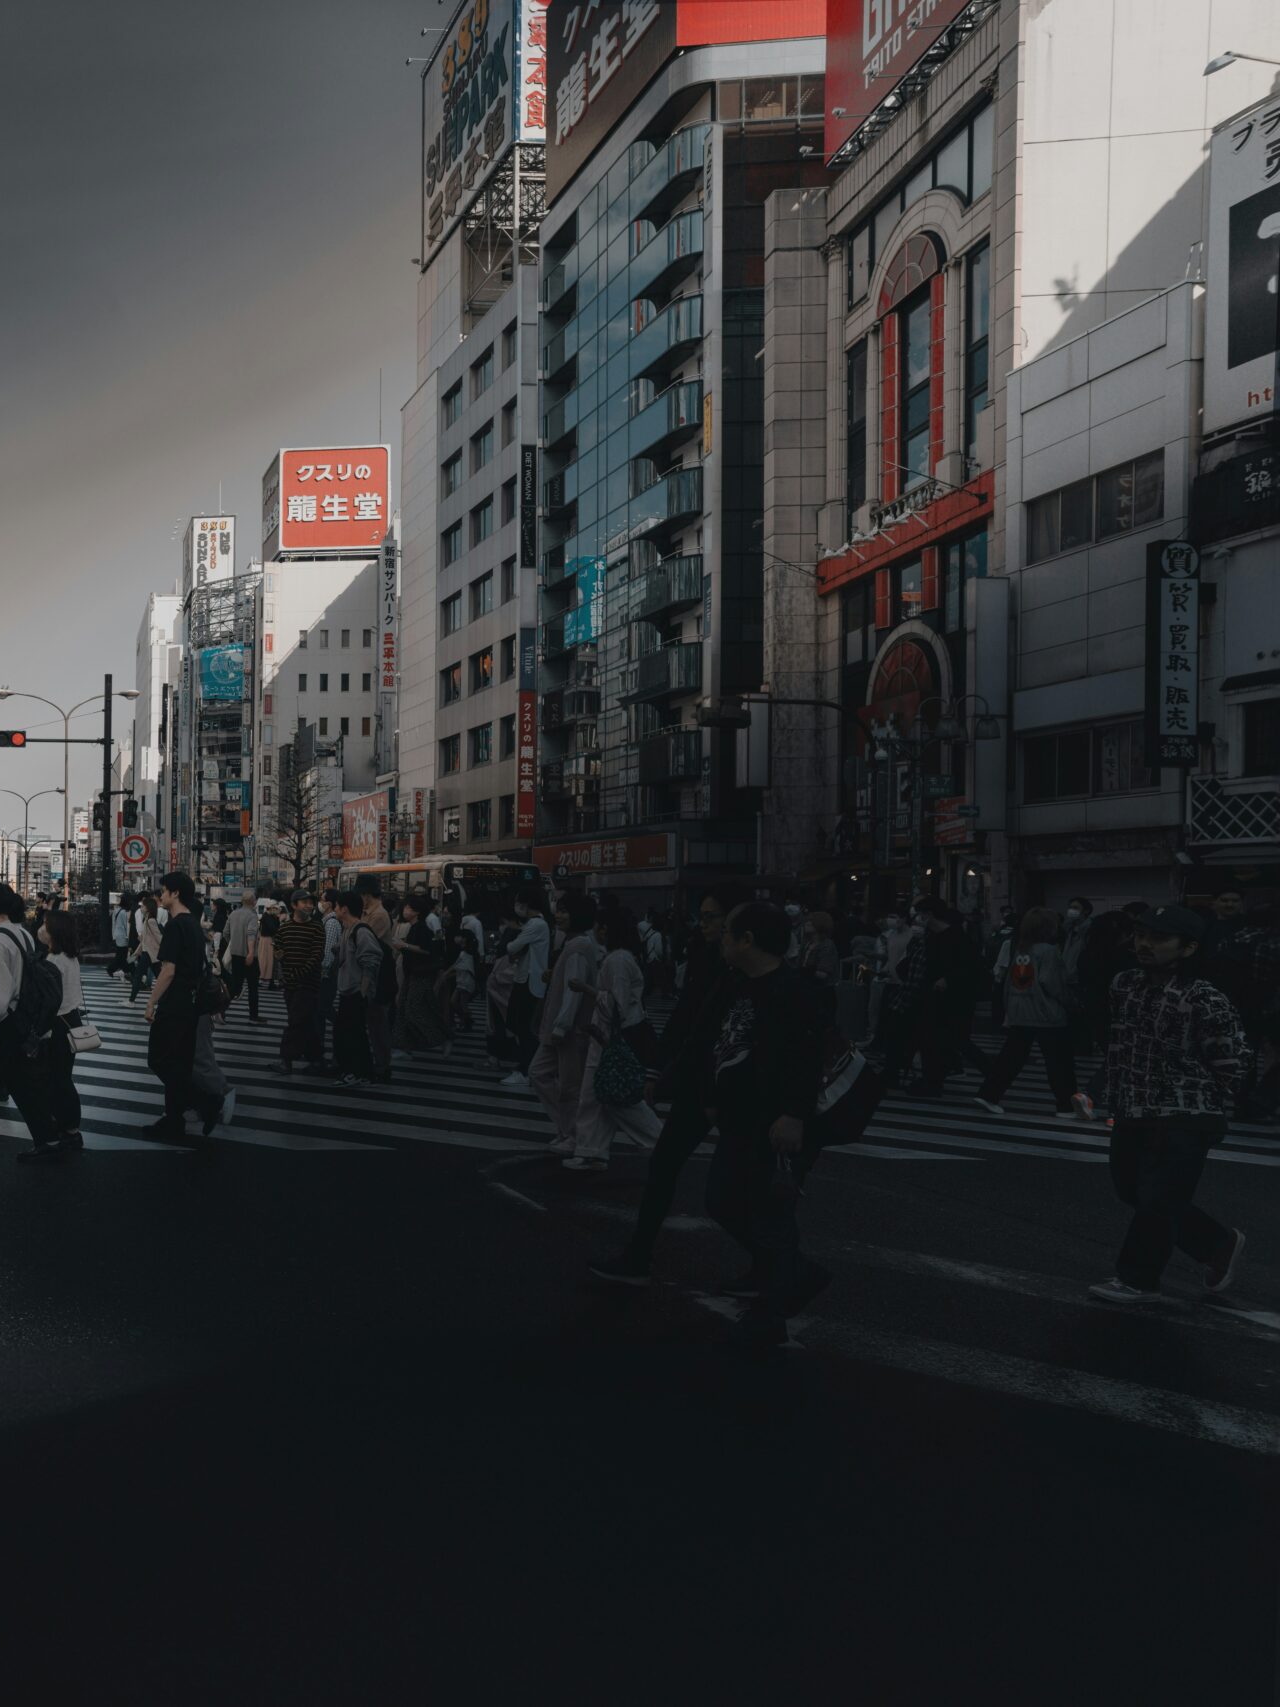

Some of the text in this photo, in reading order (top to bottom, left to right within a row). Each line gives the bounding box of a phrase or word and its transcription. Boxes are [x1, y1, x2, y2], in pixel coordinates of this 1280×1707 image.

[297, 463, 371, 482] クスリの
[286, 492, 383, 522] 龍生堂
[1166, 547, 1192, 574] 質
[383, 545, 395, 687] 新宿サンパーク 三平本館
[52, 857, 60, 867] P
[558, 842, 627, 867] クスリの龍生堂
